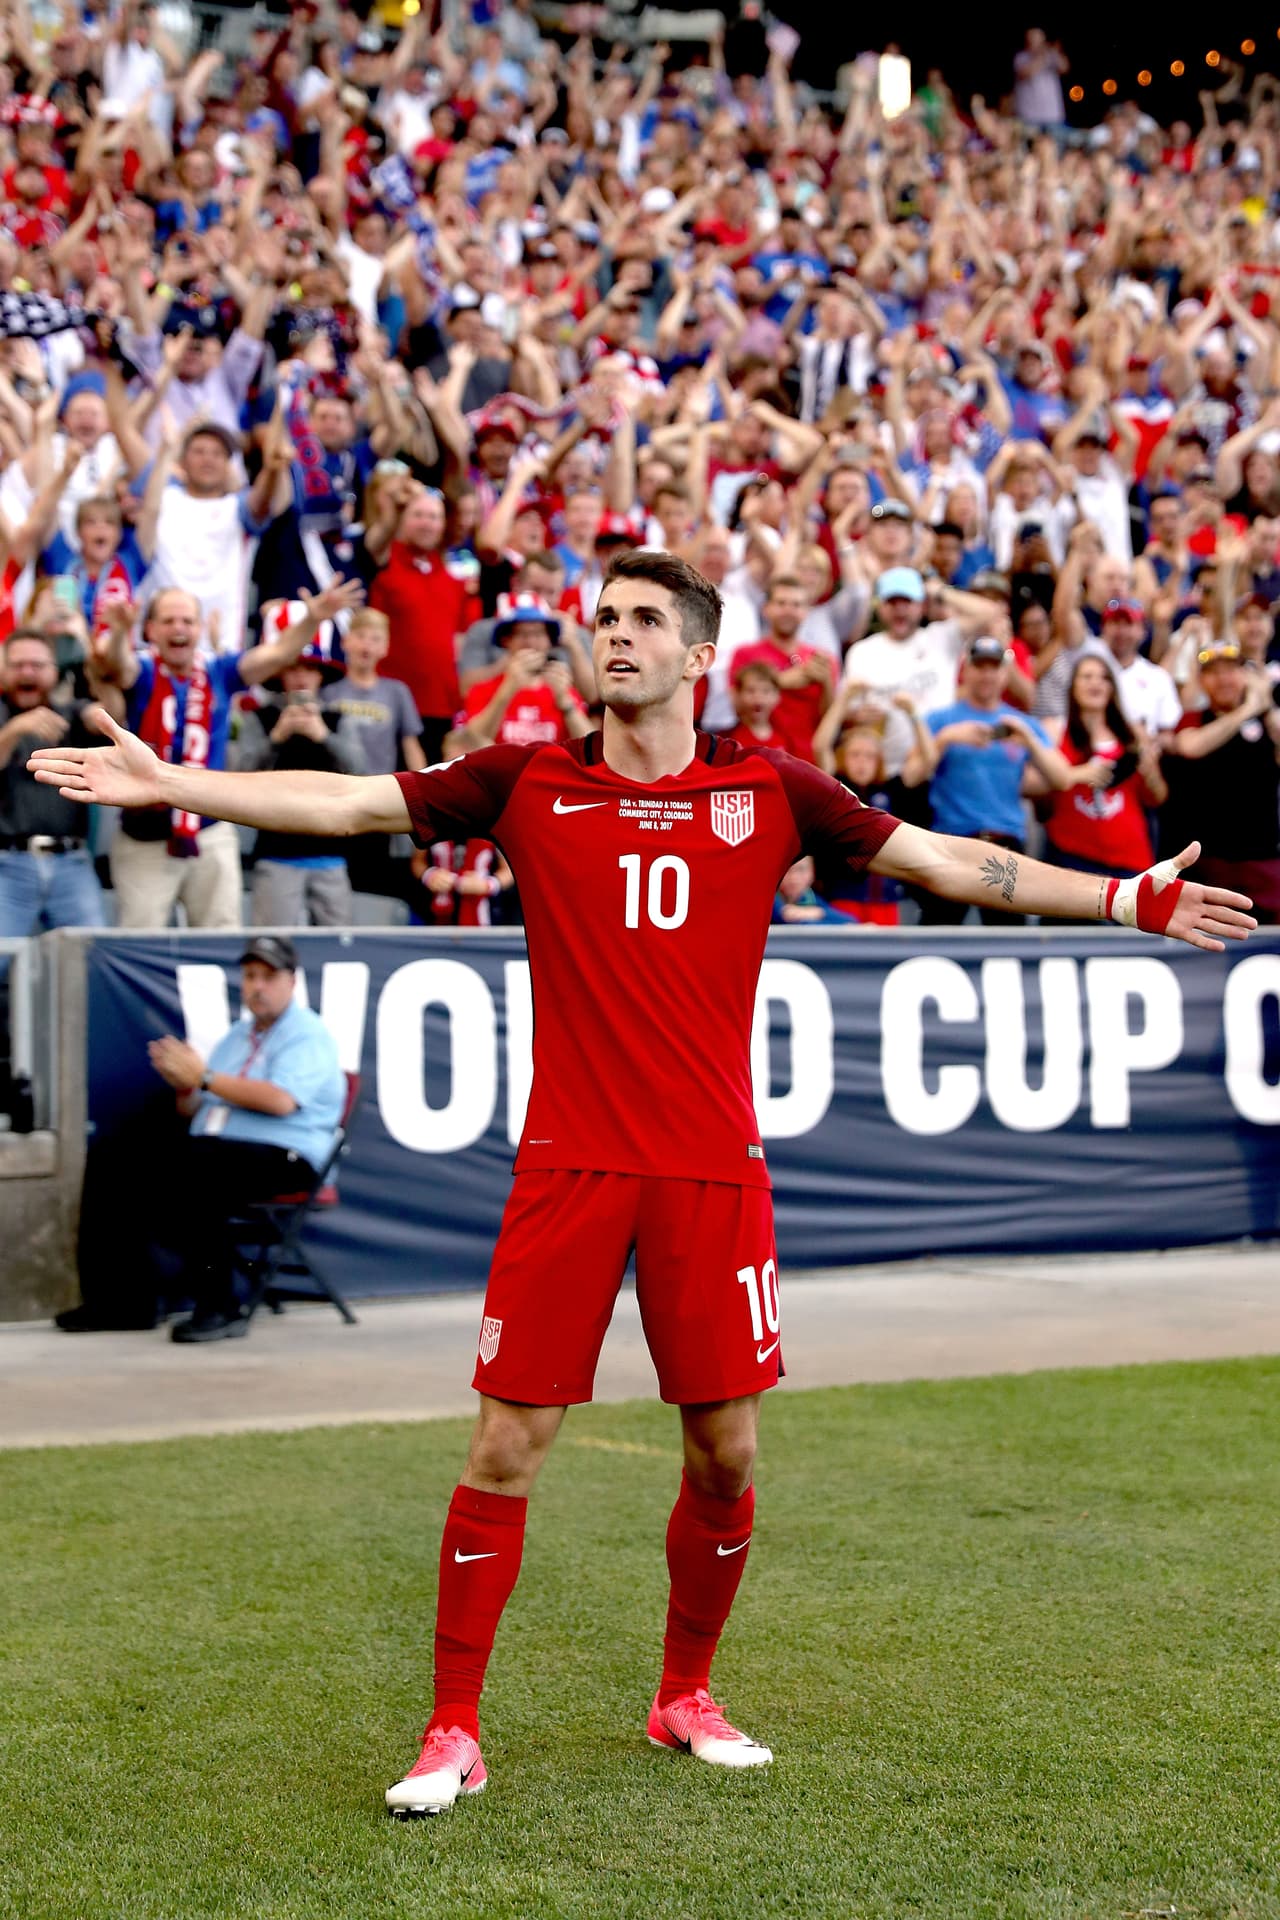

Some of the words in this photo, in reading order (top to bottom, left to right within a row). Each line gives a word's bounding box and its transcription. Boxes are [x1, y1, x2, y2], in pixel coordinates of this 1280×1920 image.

[619, 799, 632, 807] USA
[638, 800, 664, 808] TRINIDAD
[664, 801, 669, 809] &
[670, 801, 693, 810] TOBAGO
[713, 792, 751, 814] USA
[618, 808, 649, 818] COMMERCE
[649, 810, 663, 820] CITY,
[663, 810, 694, 821] COLORADO
[638, 820, 653, 830] JUNE
[660, 821, 673, 831] 2017
[618, 853, 691, 930] 10
[881, 955, 1185, 1136] CUP
[737, 1258, 780, 1341] 10
[483, 1318, 501, 1338] USA
